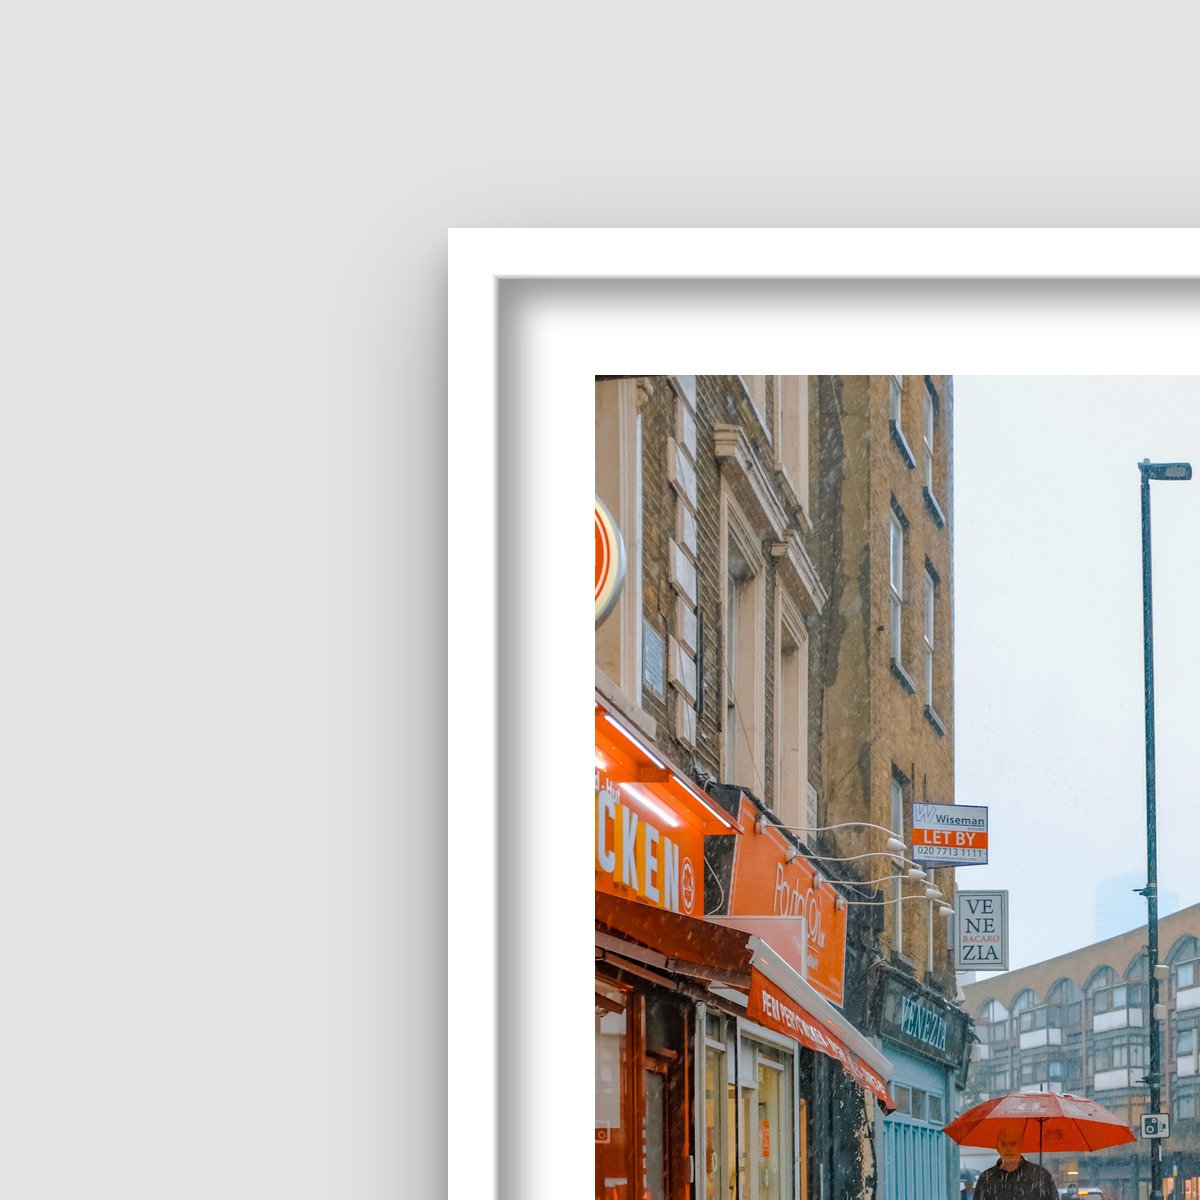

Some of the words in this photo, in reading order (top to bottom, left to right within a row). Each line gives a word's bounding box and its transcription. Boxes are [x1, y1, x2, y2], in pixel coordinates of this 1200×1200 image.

[936, 814, 985, 826] Wiseman
[923, 829, 952, 845] LET
[955, 832, 976, 847] BY
[598, 789, 680, 915] CKEN
[917, 846, 934, 854] 020
[936, 847, 958, 857] 7713
[961, 849, 982, 858] 1111
[966, 899, 994, 914] VE
[965, 918, 995, 934] NE
[963, 935, 1000, 943] BACARO
[962, 945, 999, 960] ZIA
[762, 989, 780, 1022] PERI
[780, 1002, 799, 1032] PERI
[901, 995, 947, 1052] VENEZIA
